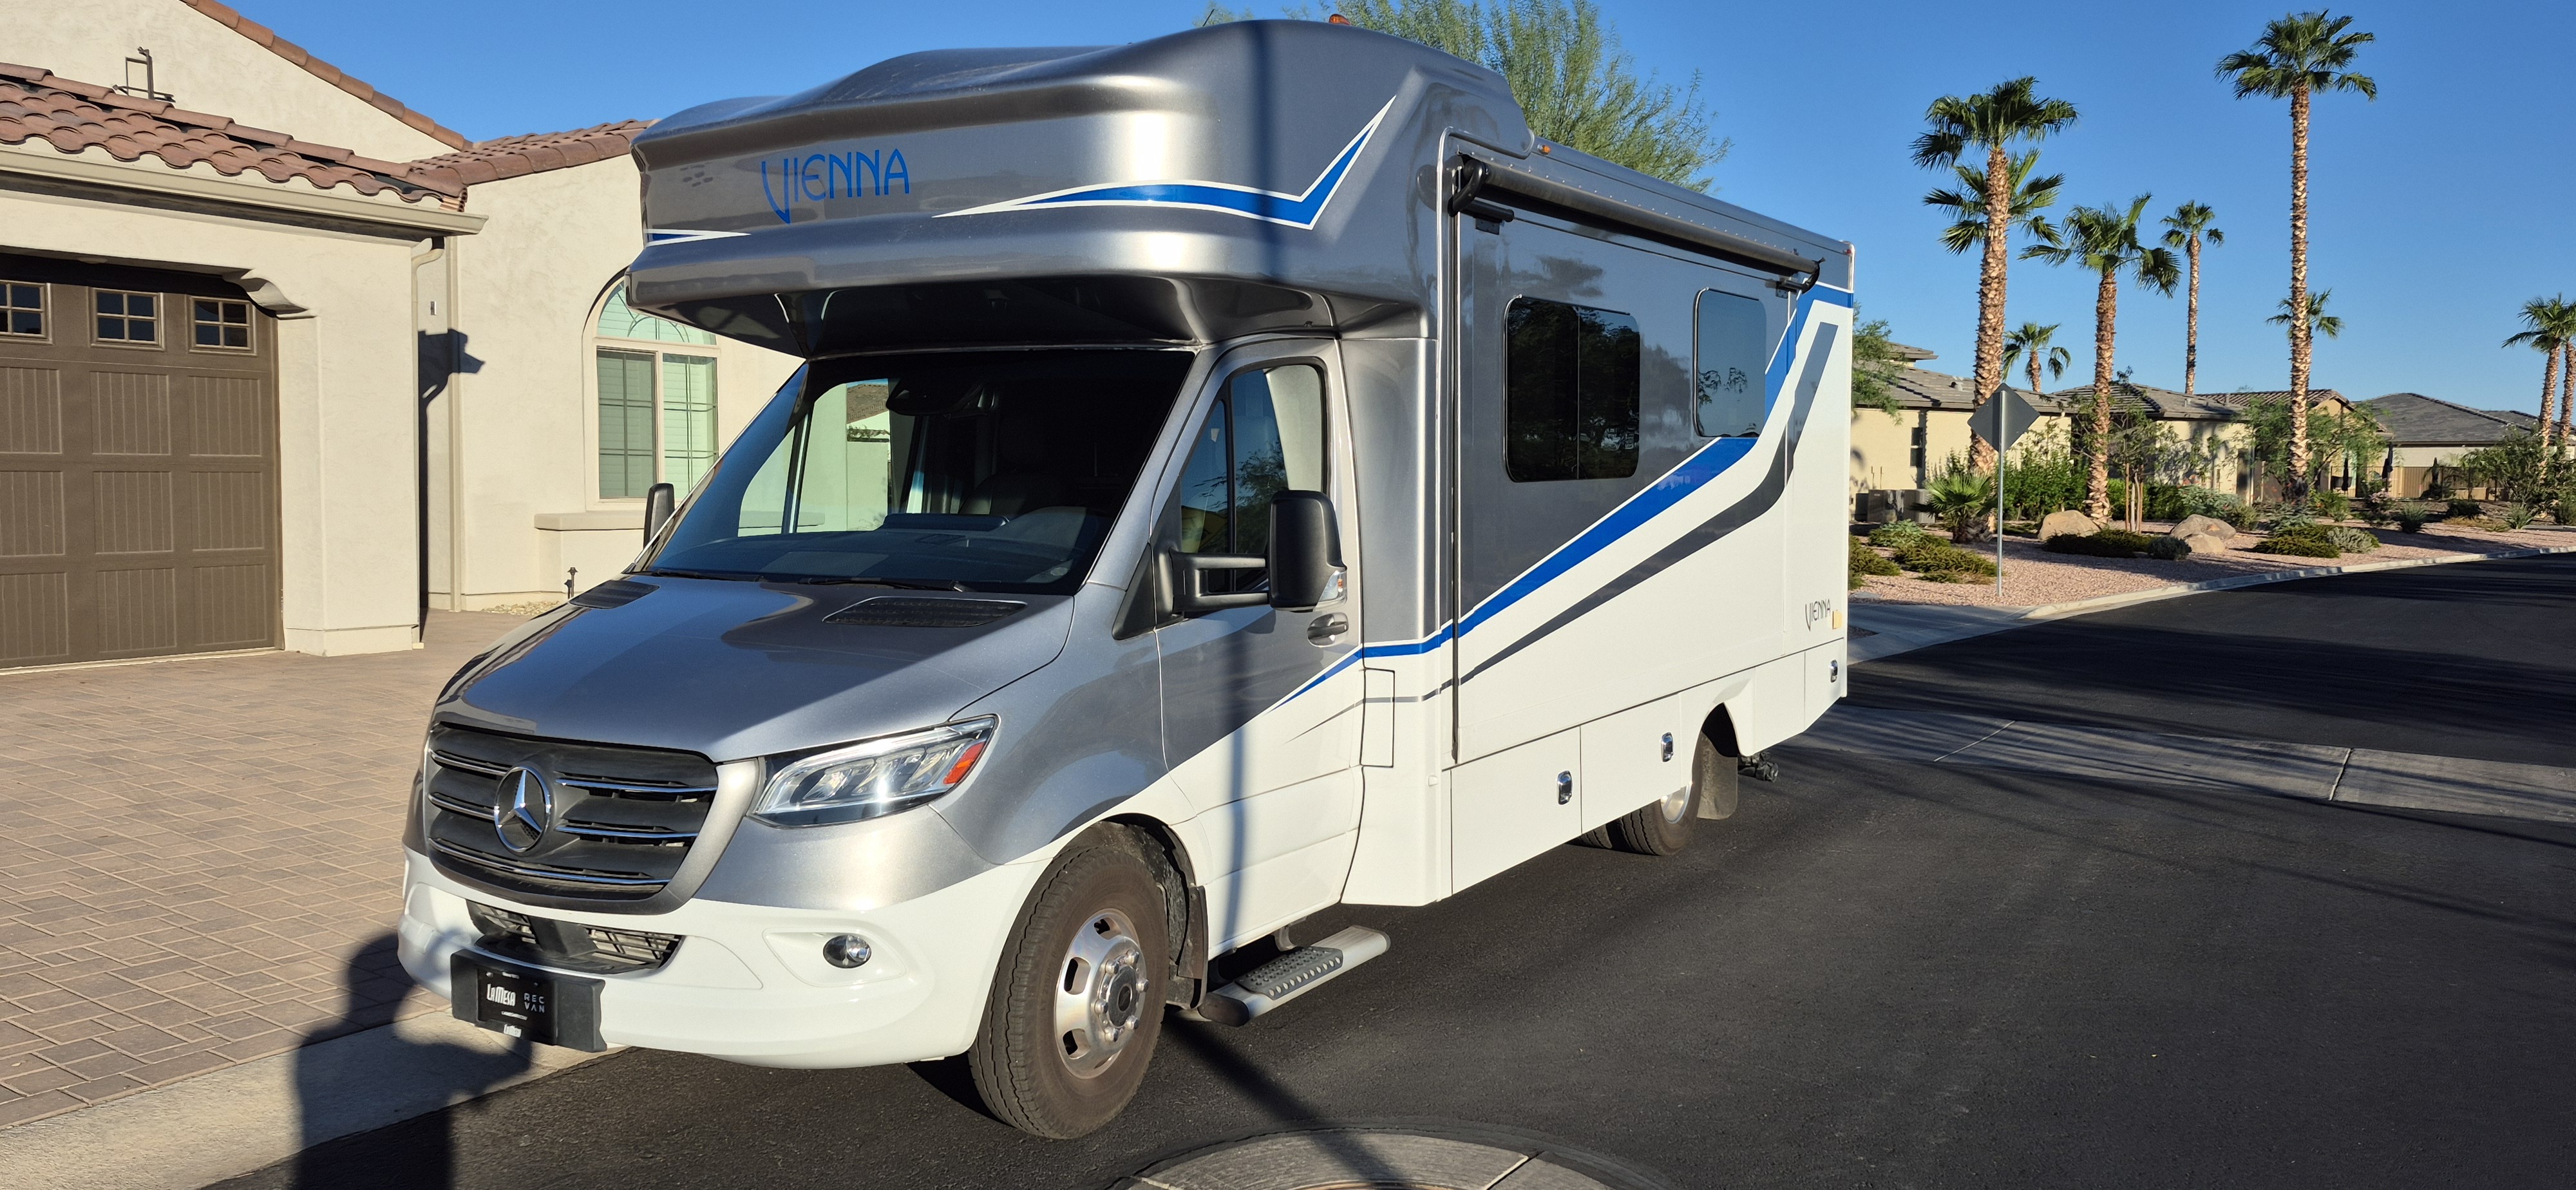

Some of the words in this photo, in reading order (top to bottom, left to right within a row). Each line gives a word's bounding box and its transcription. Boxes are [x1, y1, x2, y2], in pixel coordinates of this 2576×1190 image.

[761, 148, 910, 224] VIENNA
[1805, 599, 1831, 631] VIENNA
[524, 993, 544, 1004] REC
[524, 1002, 545, 1013] VAN
